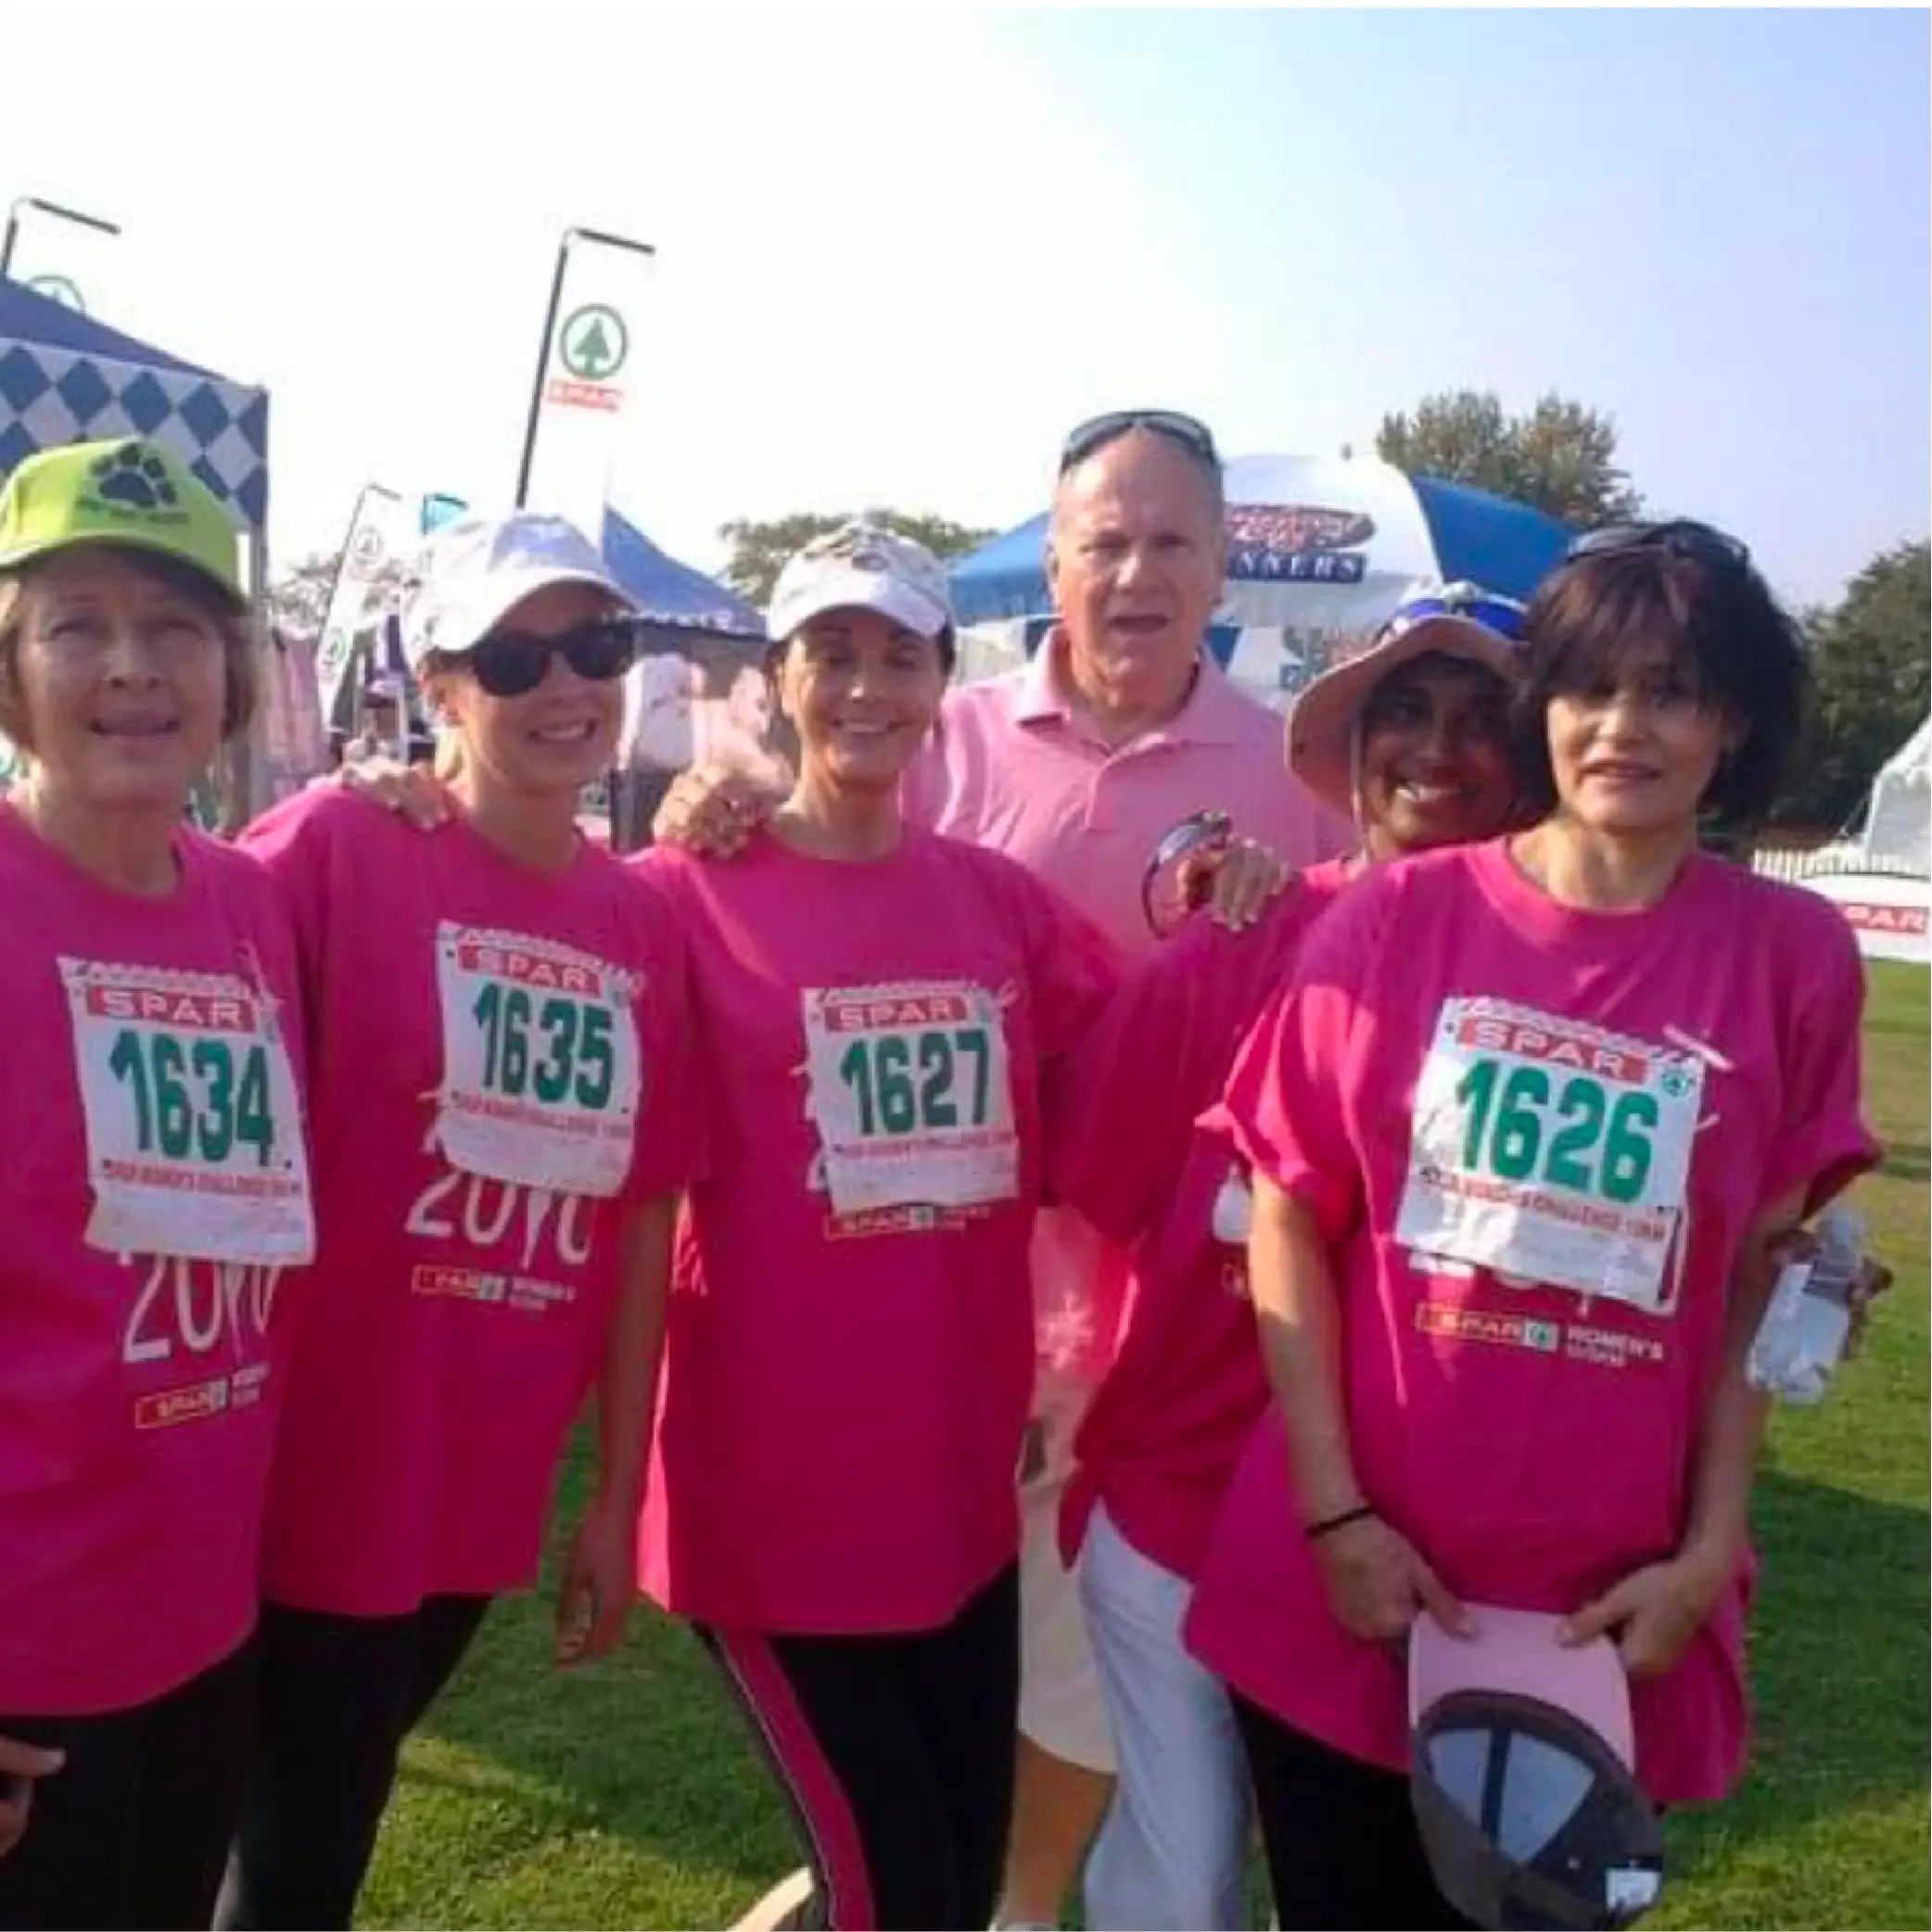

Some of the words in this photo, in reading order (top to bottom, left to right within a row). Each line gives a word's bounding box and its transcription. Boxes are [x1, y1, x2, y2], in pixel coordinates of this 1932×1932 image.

[1843, 905, 1928, 931] PAR
[479, 947, 588, 992] SPAR
[103, 989, 242, 1025] SPAR
[839, 998, 953, 1030] SPAR
[473, 983, 614, 1110] 1635
[1474, 1023, 1622, 1079] SPAR
[108, 1029, 274, 1166] 1634
[840, 1029, 990, 1136] 1627
[1456, 1057, 1658, 1202] 1626
